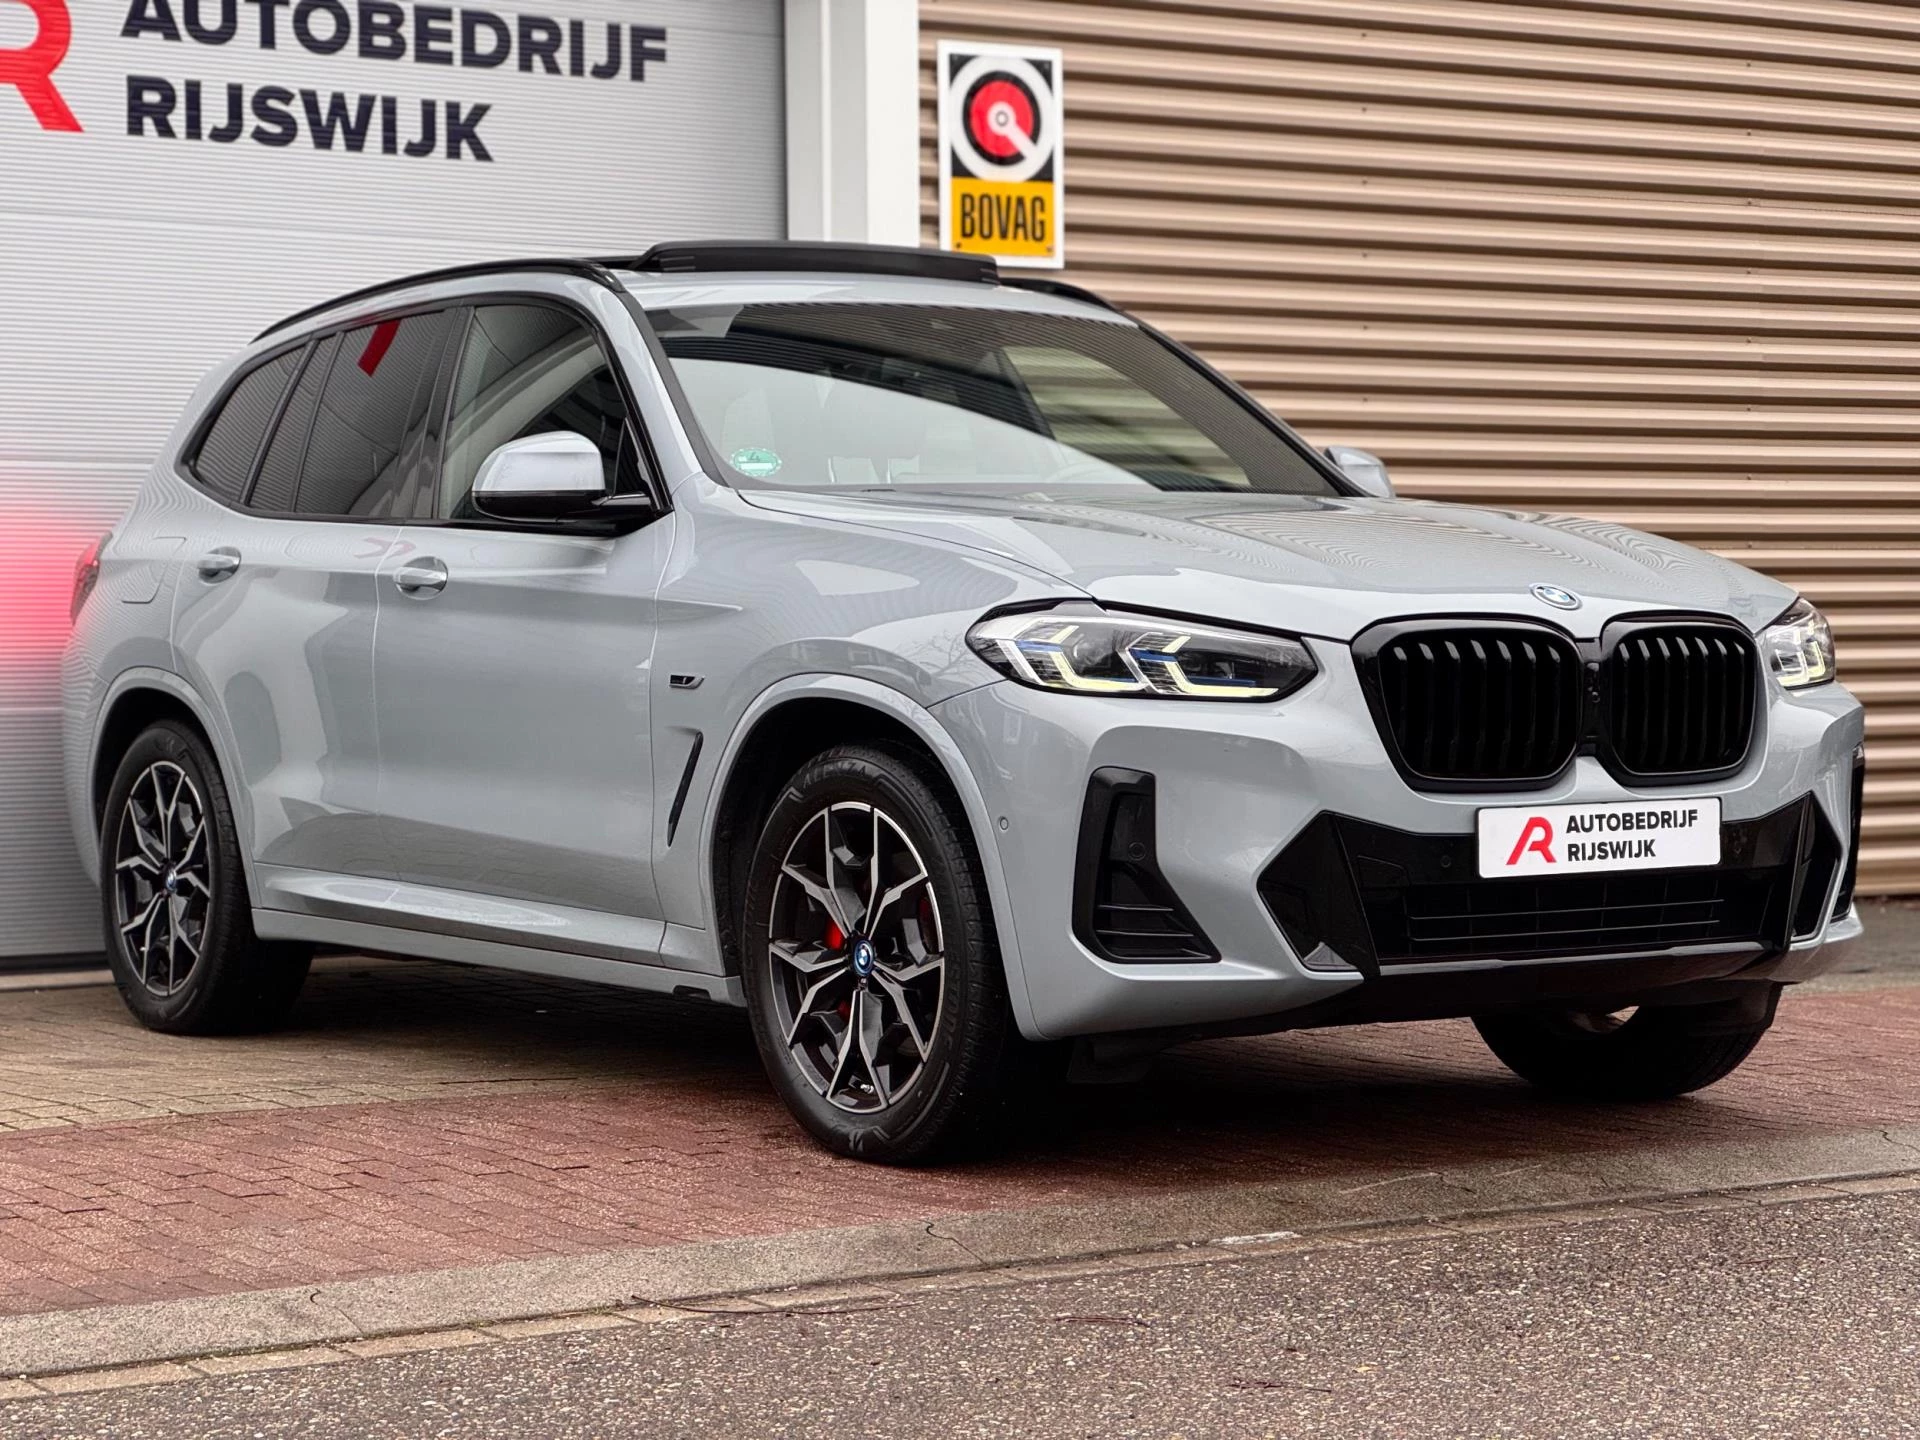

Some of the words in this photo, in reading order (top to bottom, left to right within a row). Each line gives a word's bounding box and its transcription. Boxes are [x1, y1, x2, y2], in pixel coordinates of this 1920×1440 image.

[120, 0, 668, 83] AUTOBEDRIJF
[126, 75, 494, 163] RIJSWIJK
[960, 193, 1046, 243] BOVAG
[1566, 809, 1698, 834] AUTOBEDRIJF
[1567, 839, 1656, 862] RIJSWIJK
